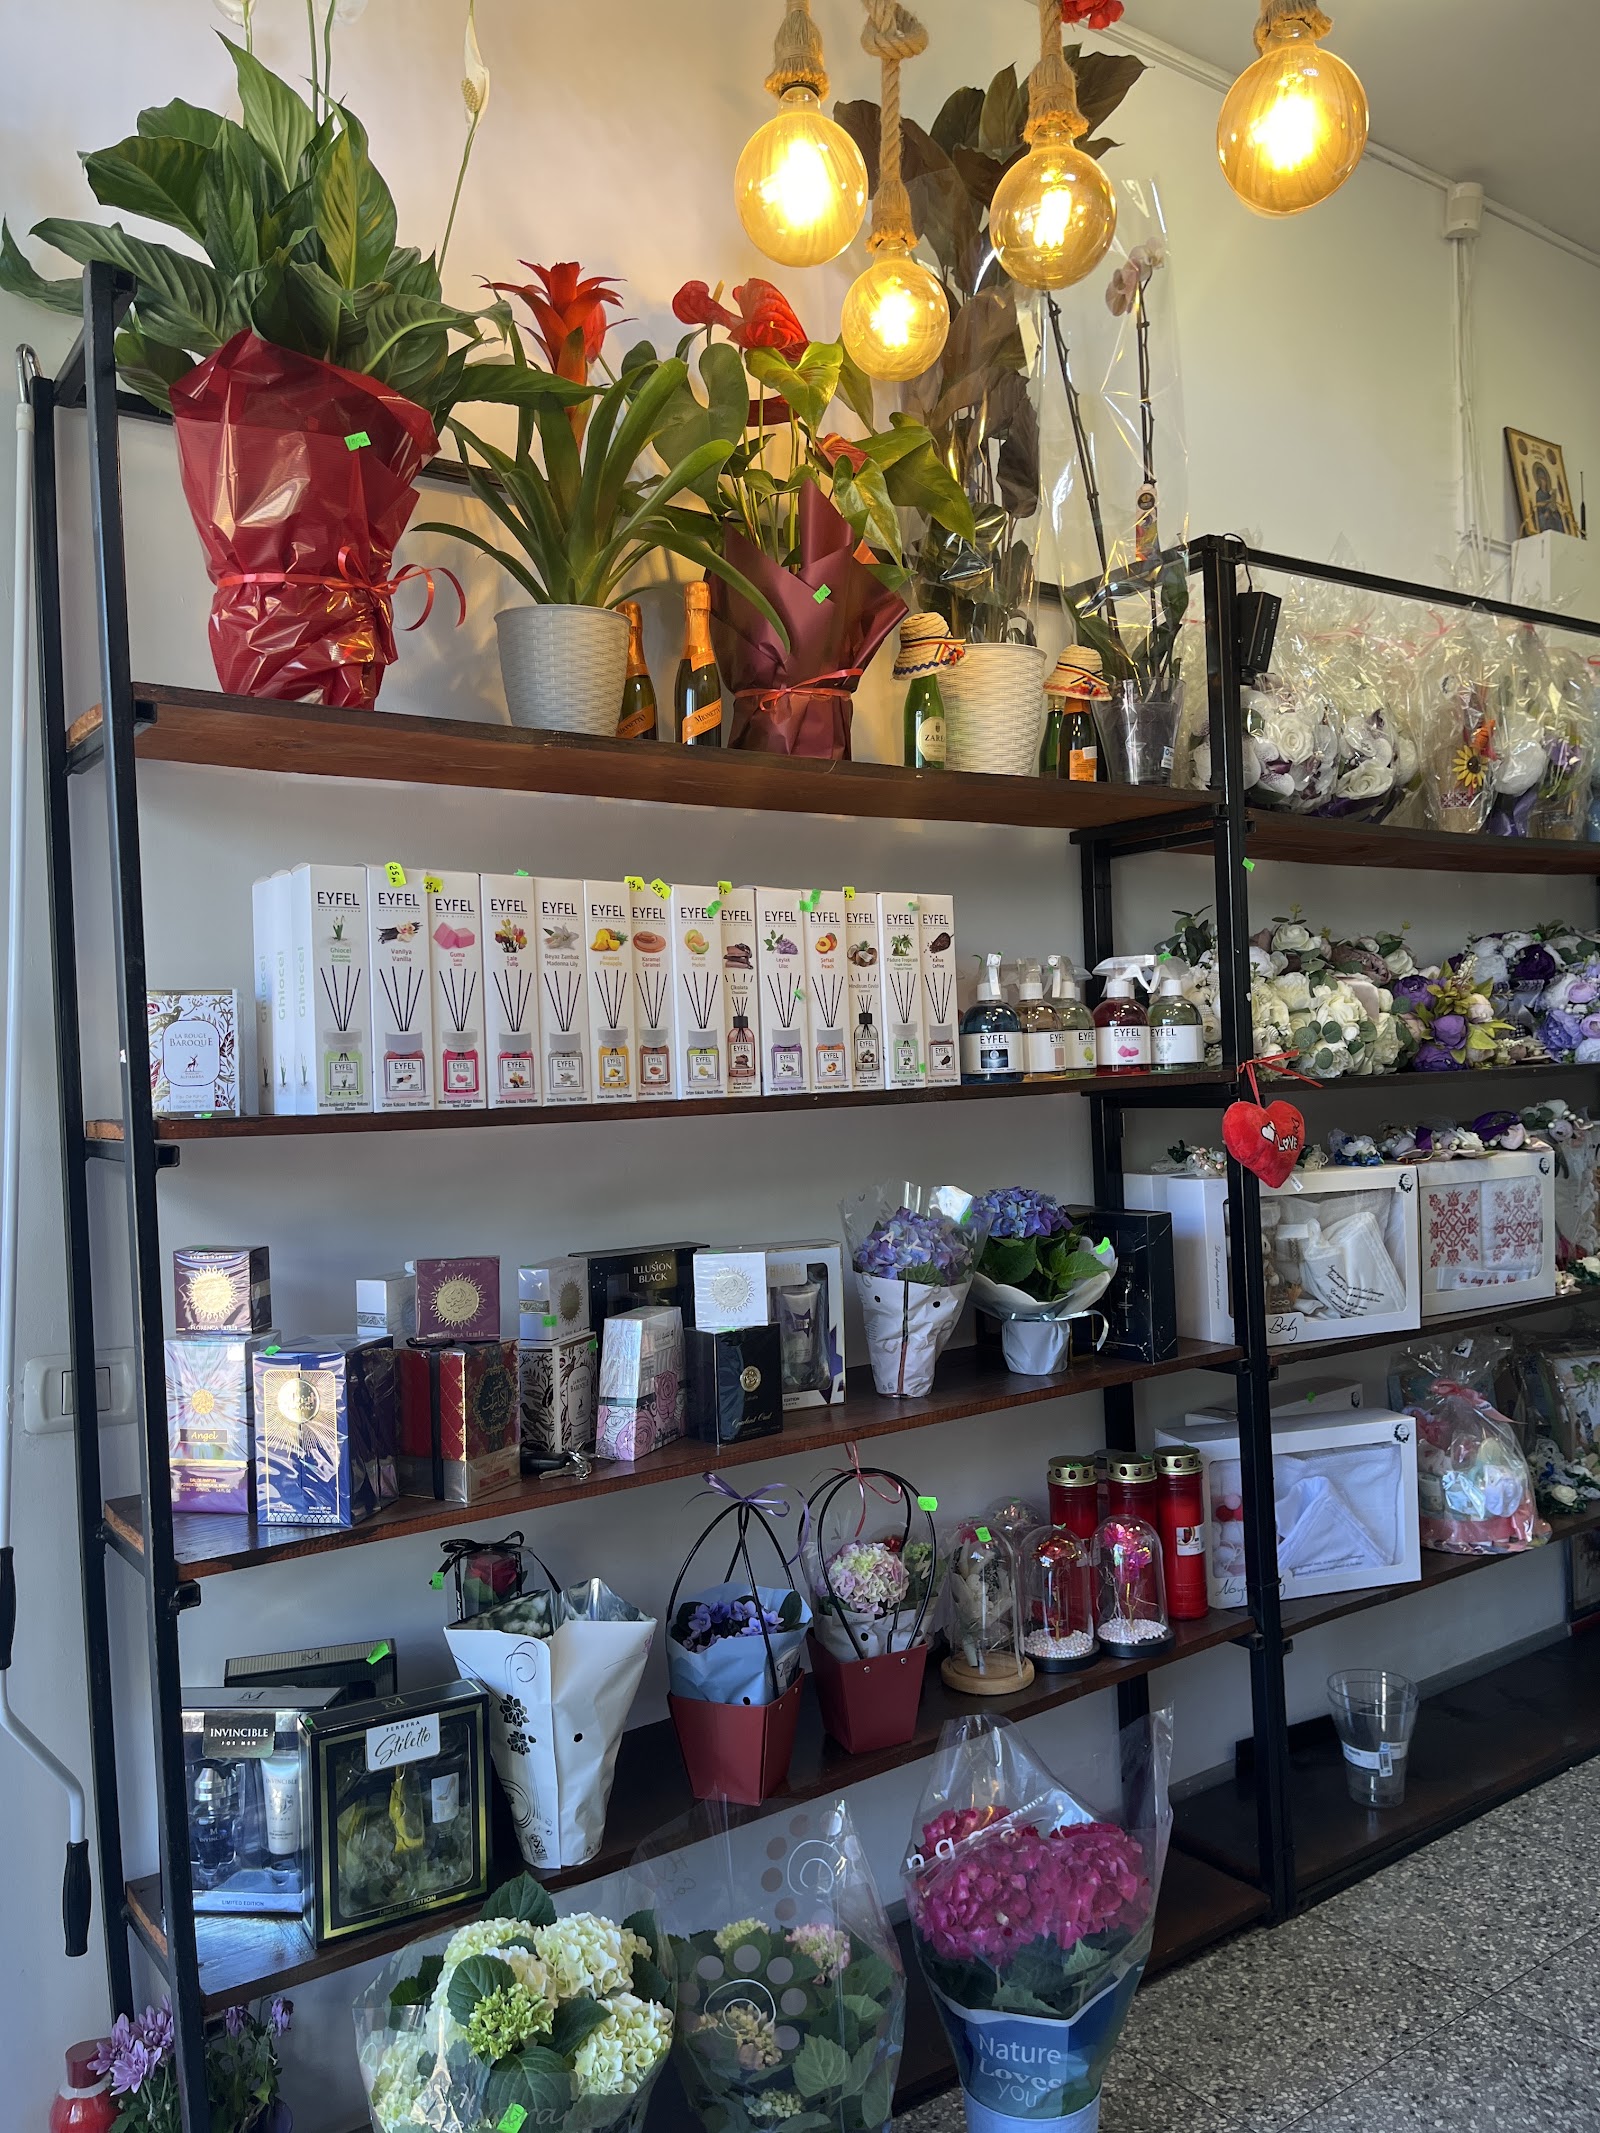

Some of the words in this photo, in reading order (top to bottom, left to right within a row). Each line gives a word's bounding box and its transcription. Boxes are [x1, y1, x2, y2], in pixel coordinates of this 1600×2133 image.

[317, 891, 360, 906] EYFEL
[378, 892, 420, 907] EYFEL
[435, 898, 474, 913] EYFEL
[491, 898, 527, 913] EYFEL
[542, 901, 577, 915] EYFEL
[591, 904, 625, 917] EYFEL
[632, 907, 666, 920] EYFEL
[721, 910, 752, 922] EYFEL
[764, 910, 796, 922] EYFEL
[810, 912, 840, 923] EYFEL
[846, 912, 875, 924] EYFEL
[886, 914, 915, 925] EYFEL
[923, 914, 949, 925] EYFEL
[1078, 1032, 1094, 1041] EYFE
[1114, 1028, 1141, 1037] EYFEL
[1150, 1028, 1176, 1036] EYFEL
[169, 1037, 213, 1047] BAROQUE
[980, 1034, 1009, 1044] EYFEL
[394, 1062, 416, 1070] EYFEL
[1275, 1132, 1298, 1151] LOVE
[633, 1261, 672, 1274] ILLUSION
[639, 1272, 667, 1284] BLACK
[1268, 1316, 1298, 1341] Baby
[191, 1431, 218, 1442] Angel
[386, 1720, 421, 1733] FERRERA
[210, 1728, 269, 1738] INVINCIBLE
[374, 1726, 431, 1765] Stiletto
[379, 1904, 408, 1916] LIMITED
[409, 1894, 437, 1909] EDITION
[978, 2032, 1061, 2065] Nature
[980, 2059, 1062, 2092] Loves
